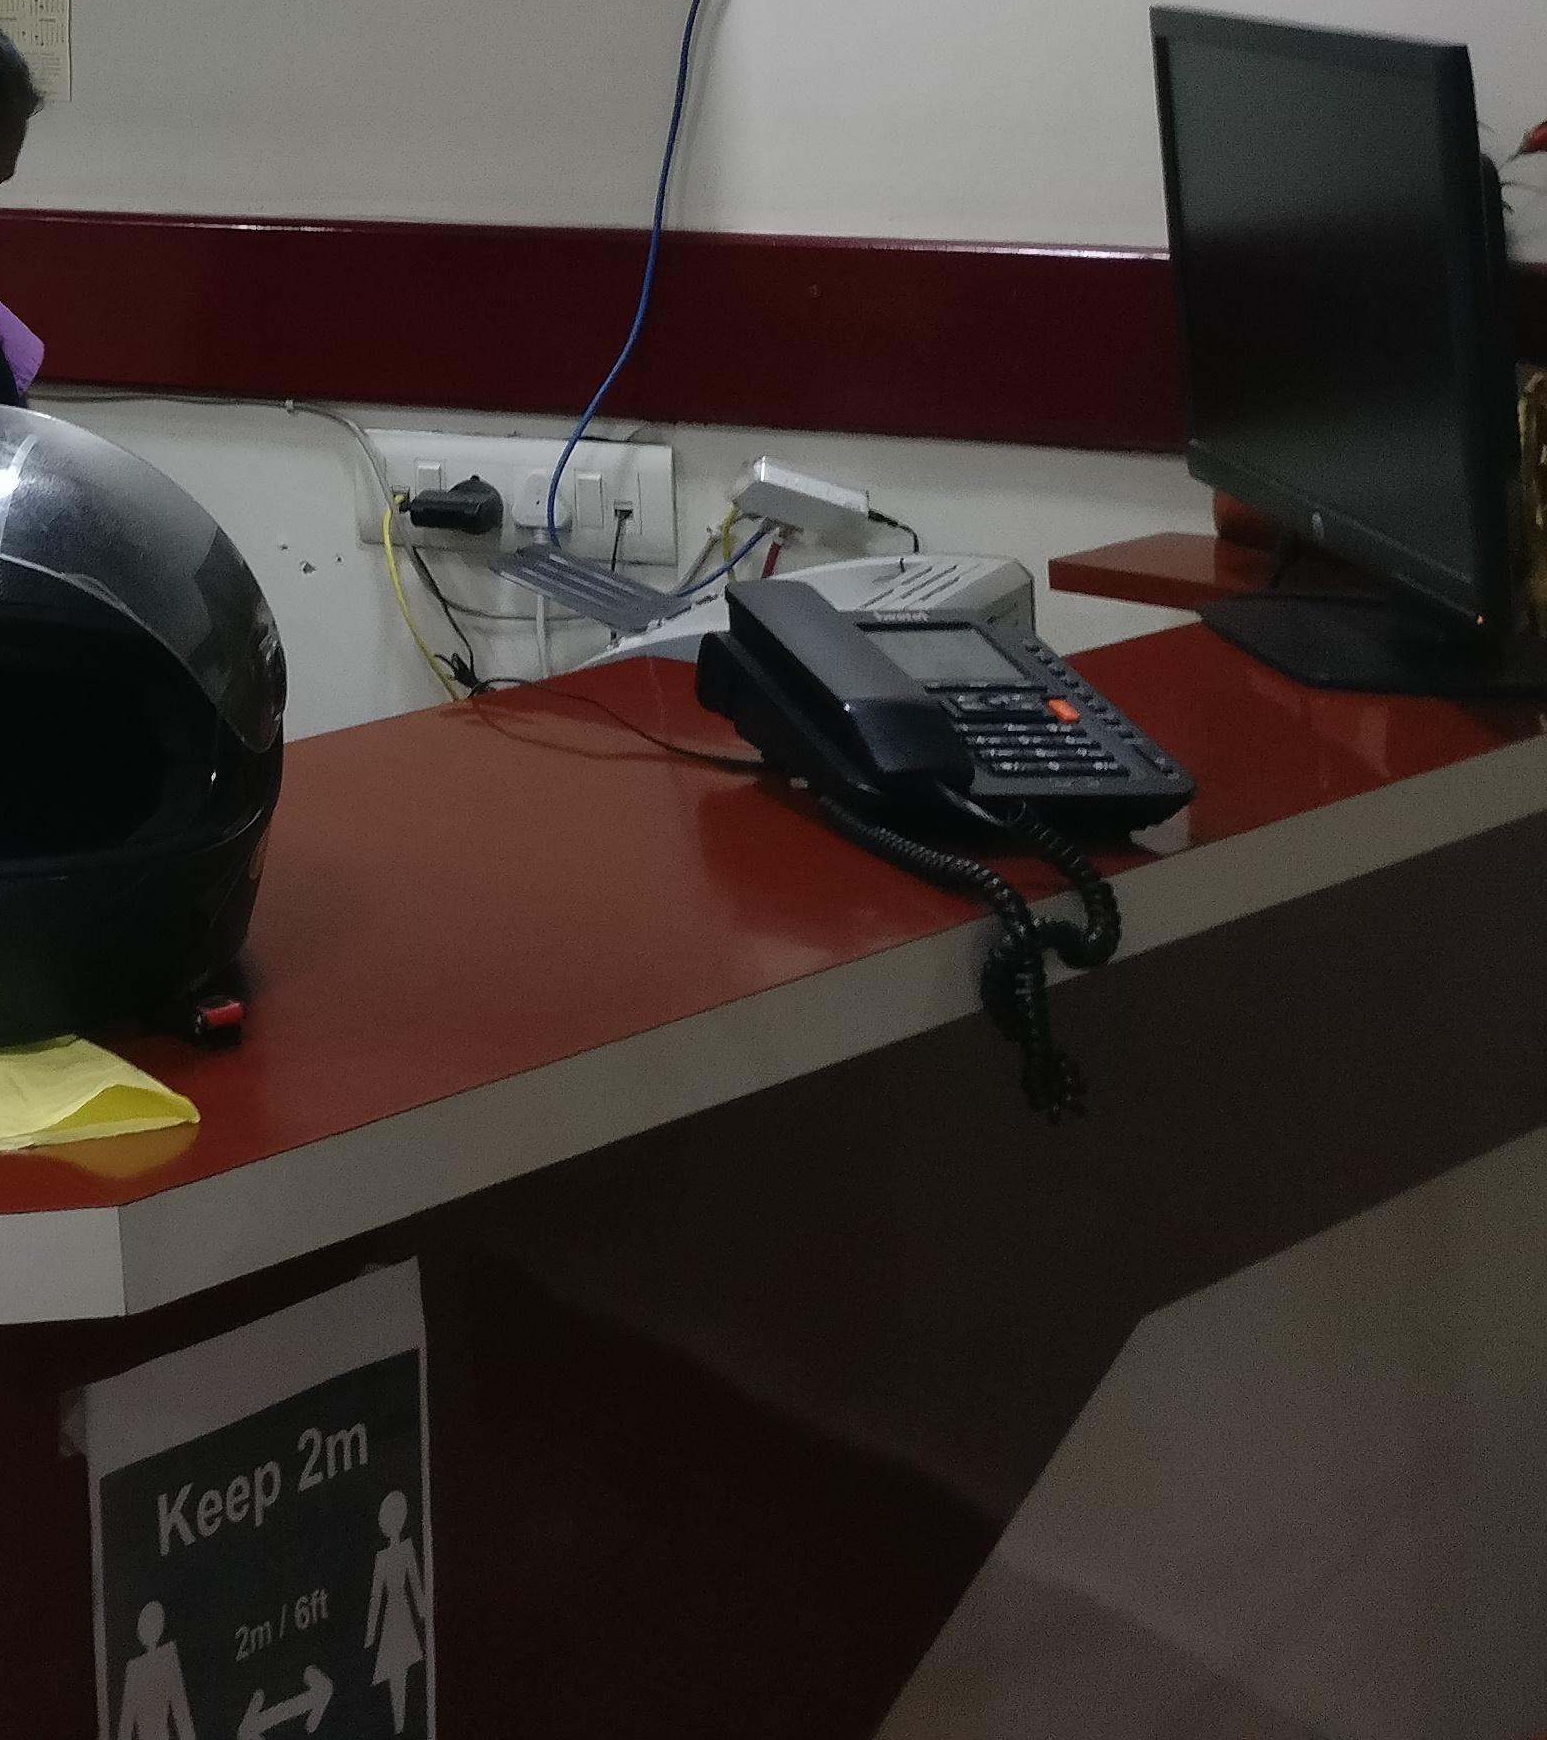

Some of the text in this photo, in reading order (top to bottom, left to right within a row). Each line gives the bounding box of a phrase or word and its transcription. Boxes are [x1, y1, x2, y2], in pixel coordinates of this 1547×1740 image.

[157, 1421, 369, 1557] Keep 2m
[234, 1620, 272, 1662] 2m
[294, 1588, 329, 1630] 6ft
